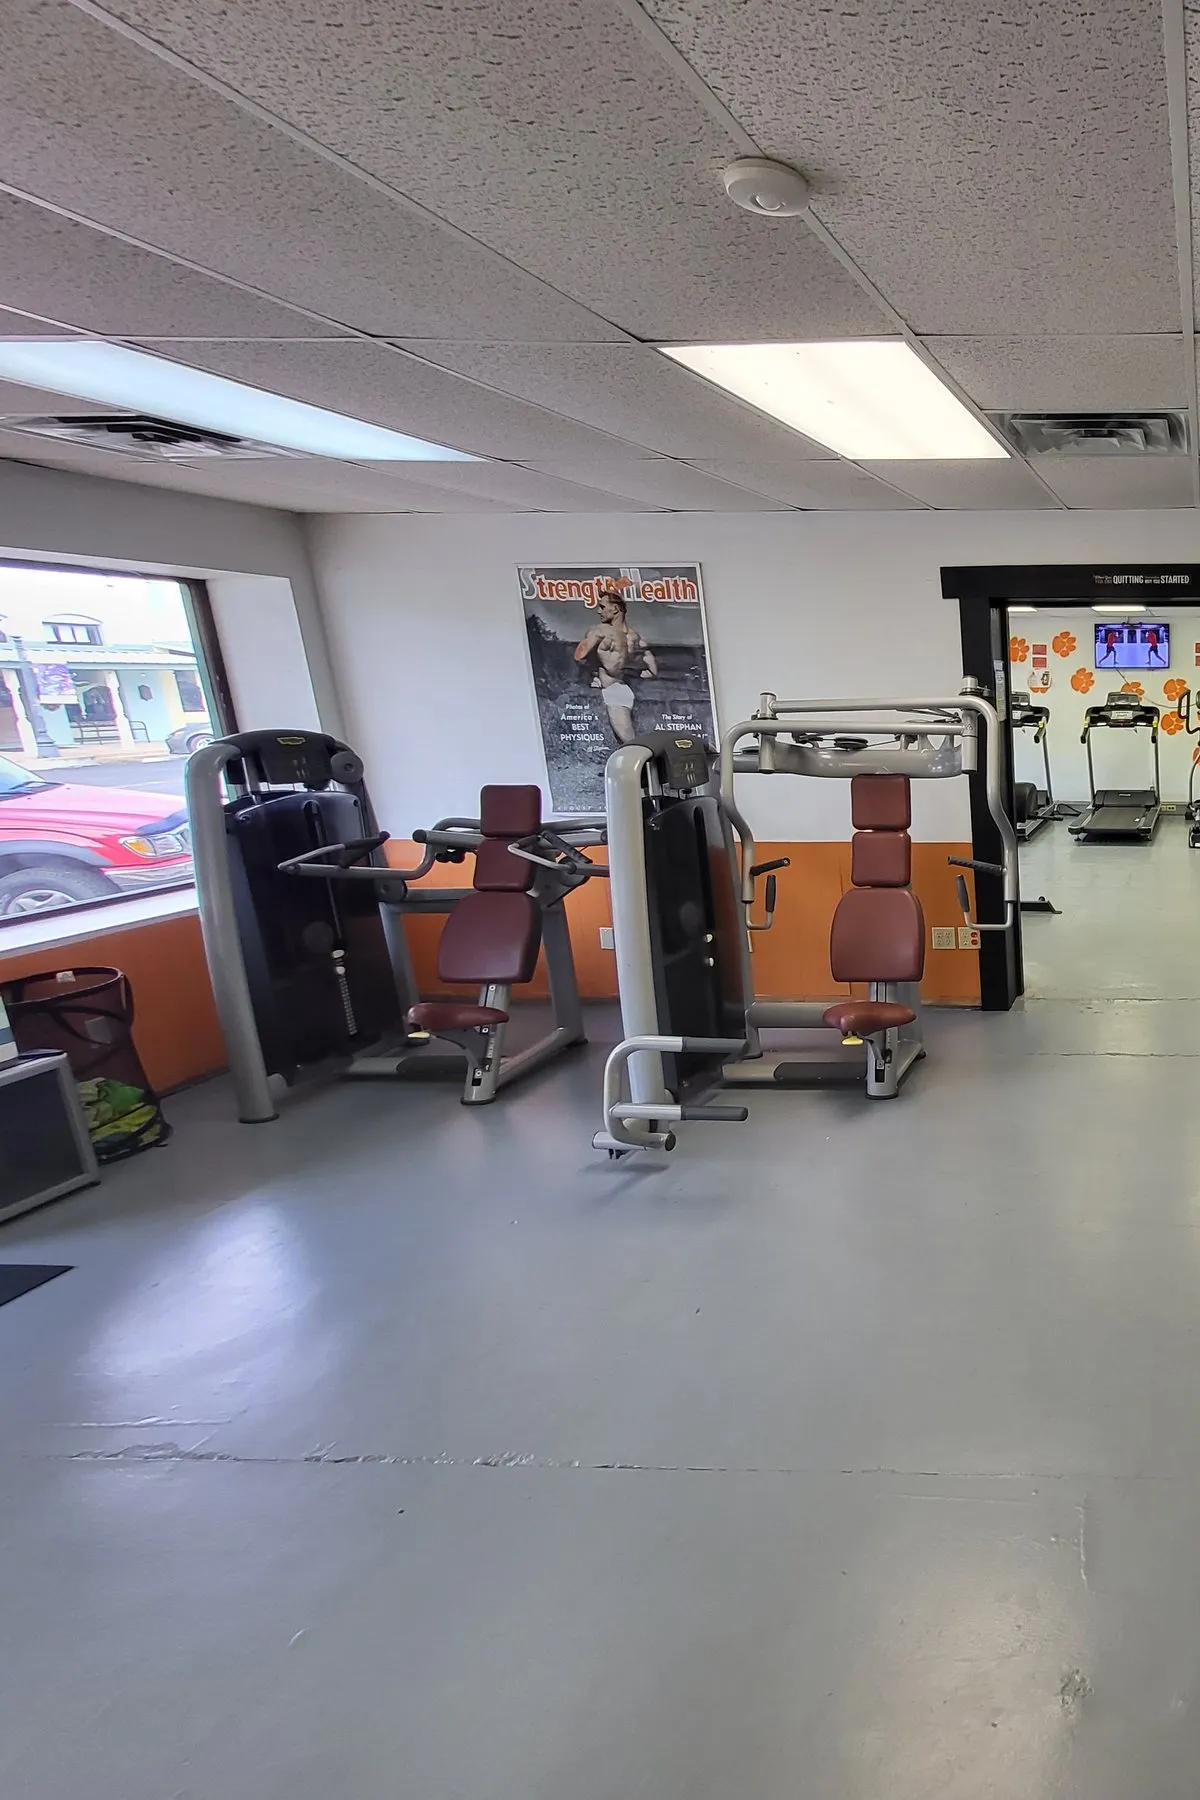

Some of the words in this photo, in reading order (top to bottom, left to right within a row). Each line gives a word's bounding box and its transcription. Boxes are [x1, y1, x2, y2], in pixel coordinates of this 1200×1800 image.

[1113, 575, 1144, 585] QUITTING
[1160, 575, 1190, 584] STARTED
[618, 567, 699, 603] Health
[560, 712, 599, 721] America's
[571, 723, 590, 731] BEST
[654, 723, 666, 731] AL
[666, 723, 702, 731] STEPHAN
[560, 733, 605, 742] PHYSIQUES
